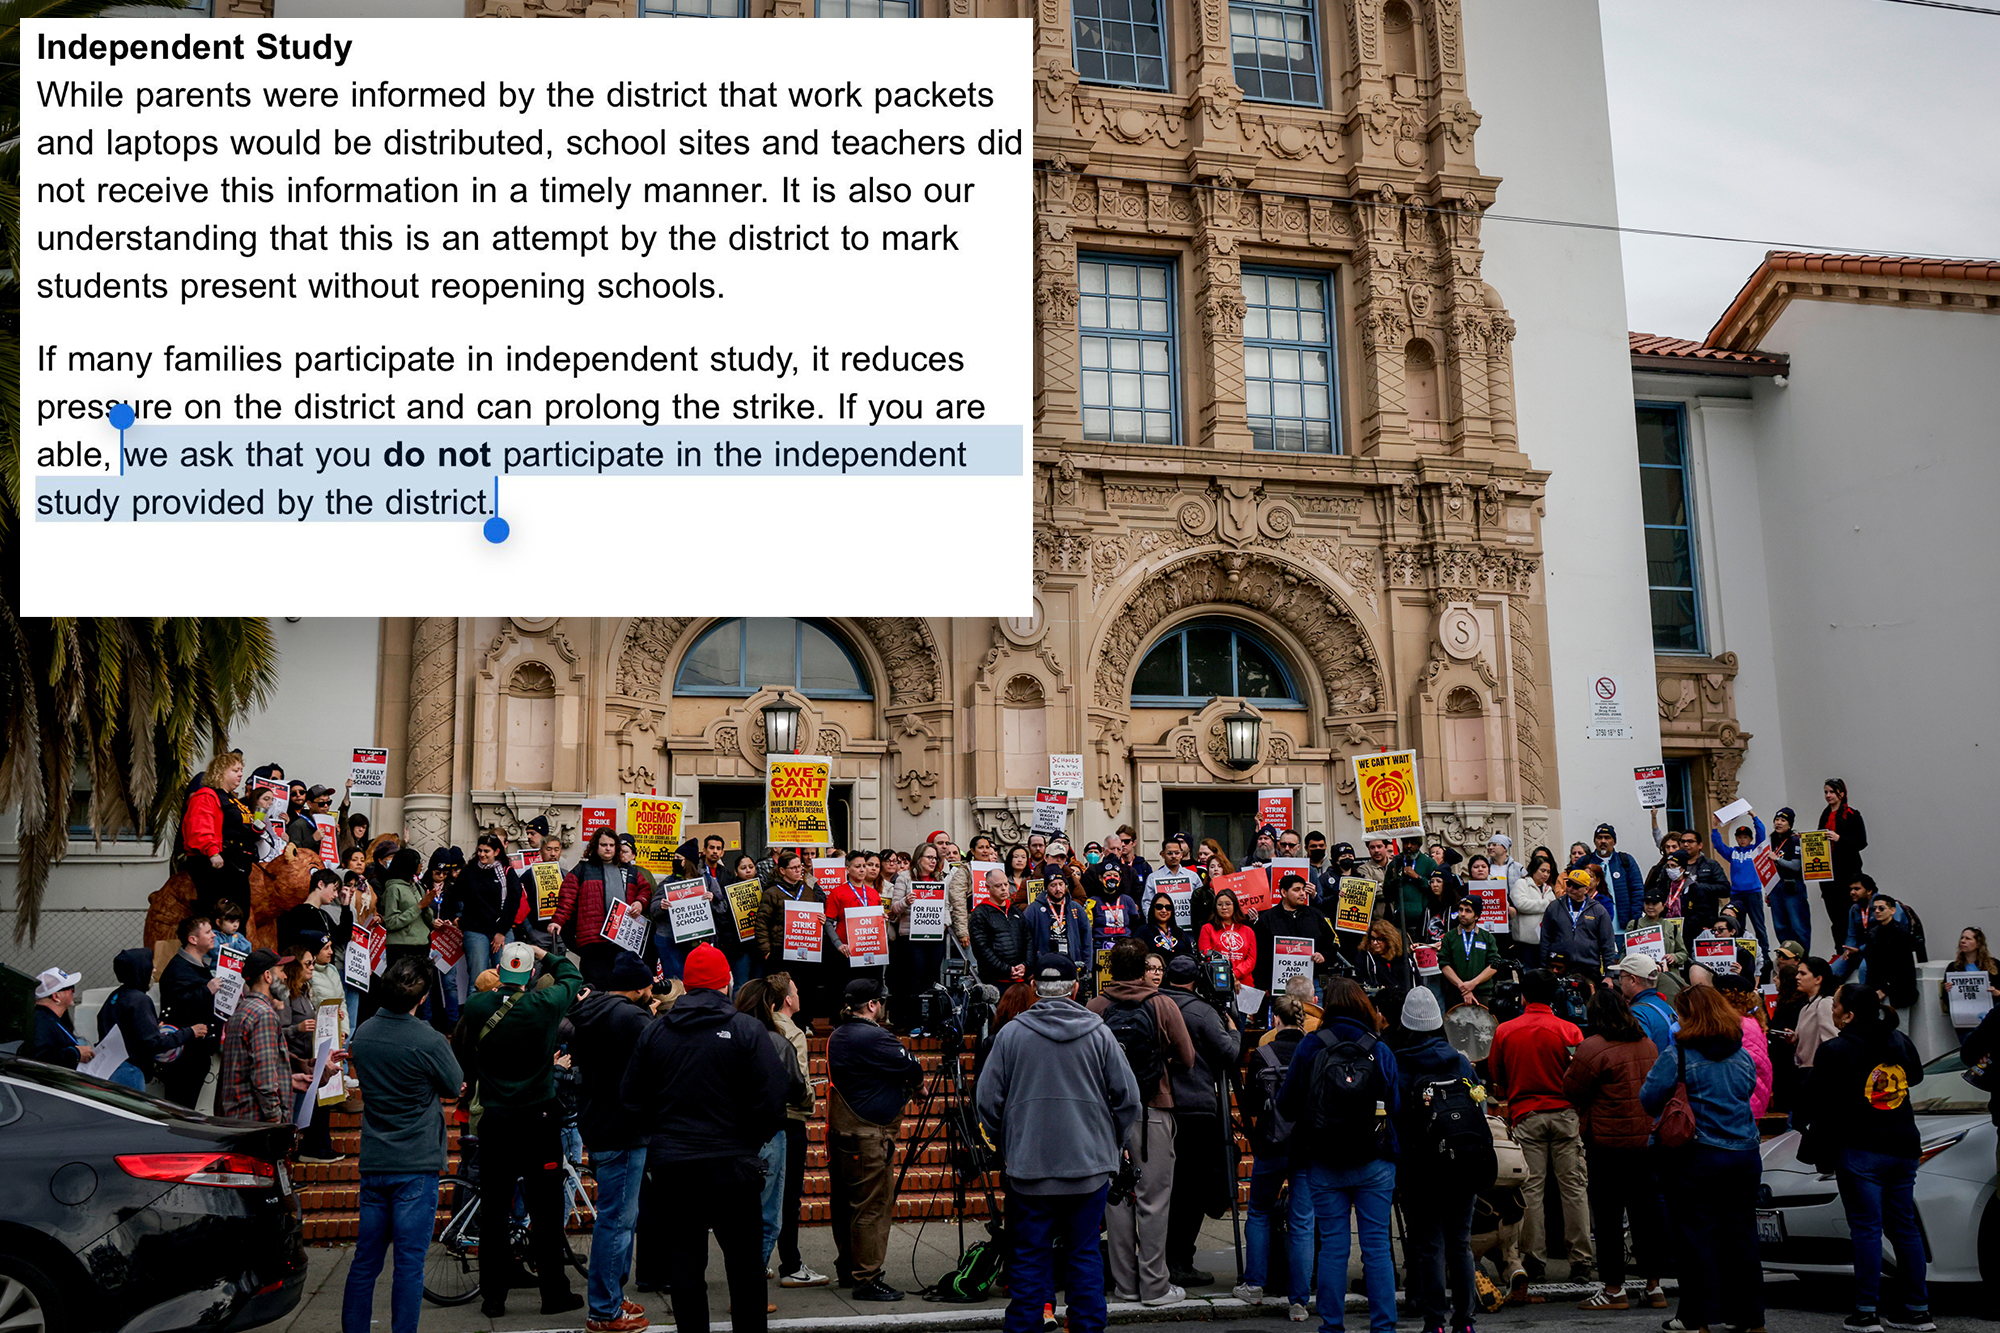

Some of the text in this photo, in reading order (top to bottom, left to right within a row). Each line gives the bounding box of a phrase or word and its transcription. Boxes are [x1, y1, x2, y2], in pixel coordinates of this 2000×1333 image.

[1454, 620, 1470, 645] S
[1358, 754, 1410, 769] WE CAN'T WAIT
[784, 767, 814, 778] WE
[772, 788, 822, 798] WAIT
[1379, 790, 1399, 806] UP
[642, 802, 670, 813] NO
[804, 800, 823, 808] SCHOOLS
[588, 818, 611, 826] STRIKE
[636, 811, 677, 825] PODEMOS
[1370, 818, 1380, 826] FOR
[1390, 815, 1412, 824] SCHOOLS
[637, 822, 674, 836] ESPERAR
[1366, 826, 1375, 834] OUR
[1375, 823, 1399, 832] STUDENTS
[672, 902, 708, 915] FOR FULLY
[676, 909, 706, 921] STAFFED
[798, 912, 811, 920] ON
[676, 915, 709, 928] SCHOOLS
[792, 921, 817, 930] STRIKE
[860, 918, 872, 926] ON
[854, 927, 879, 936] STRIKE
[788, 941, 818, 949] HEALTHCARE
[1294, 960, 1309, 968] SAFE
